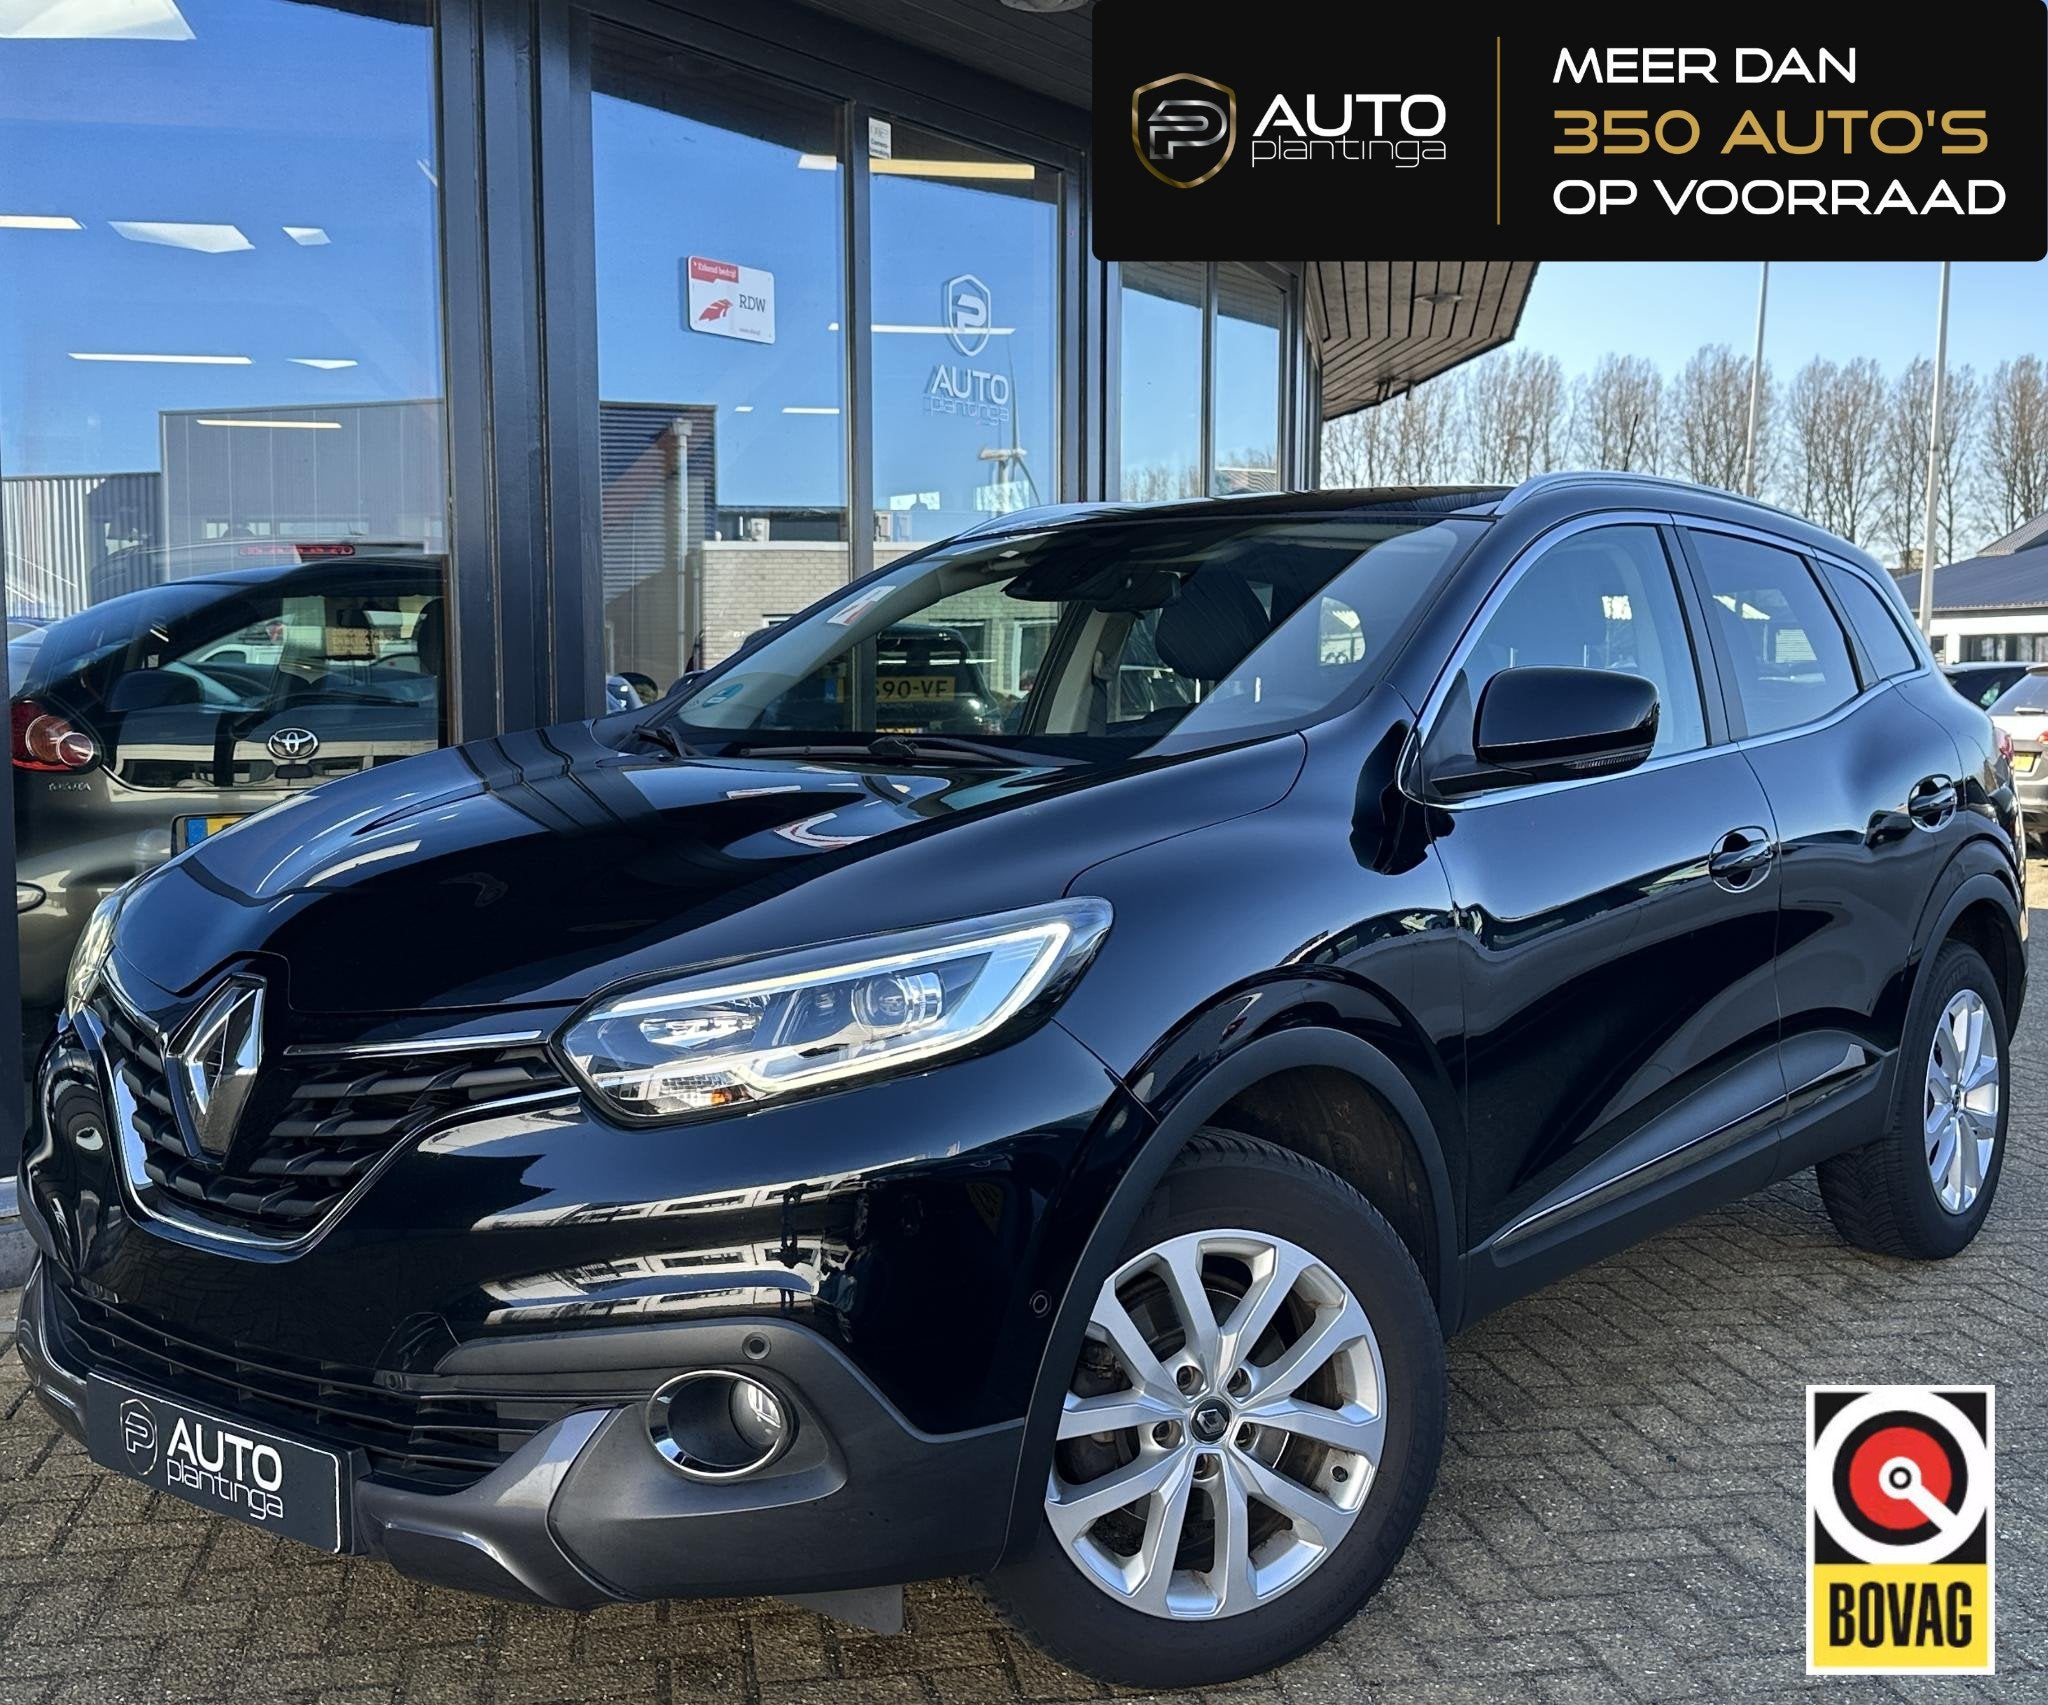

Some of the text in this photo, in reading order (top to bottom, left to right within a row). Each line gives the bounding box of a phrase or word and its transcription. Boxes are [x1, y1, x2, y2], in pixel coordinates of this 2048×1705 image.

[739, 294, 766, 312] RDW
[931, 365, 1009, 405] AUTO
[930, 395, 1009, 425] plantinga
[875, 680, 948, 699] 90-VF
[167, 1417, 283, 1492] AUTO
[167, 1458, 284, 1520] plantinga
